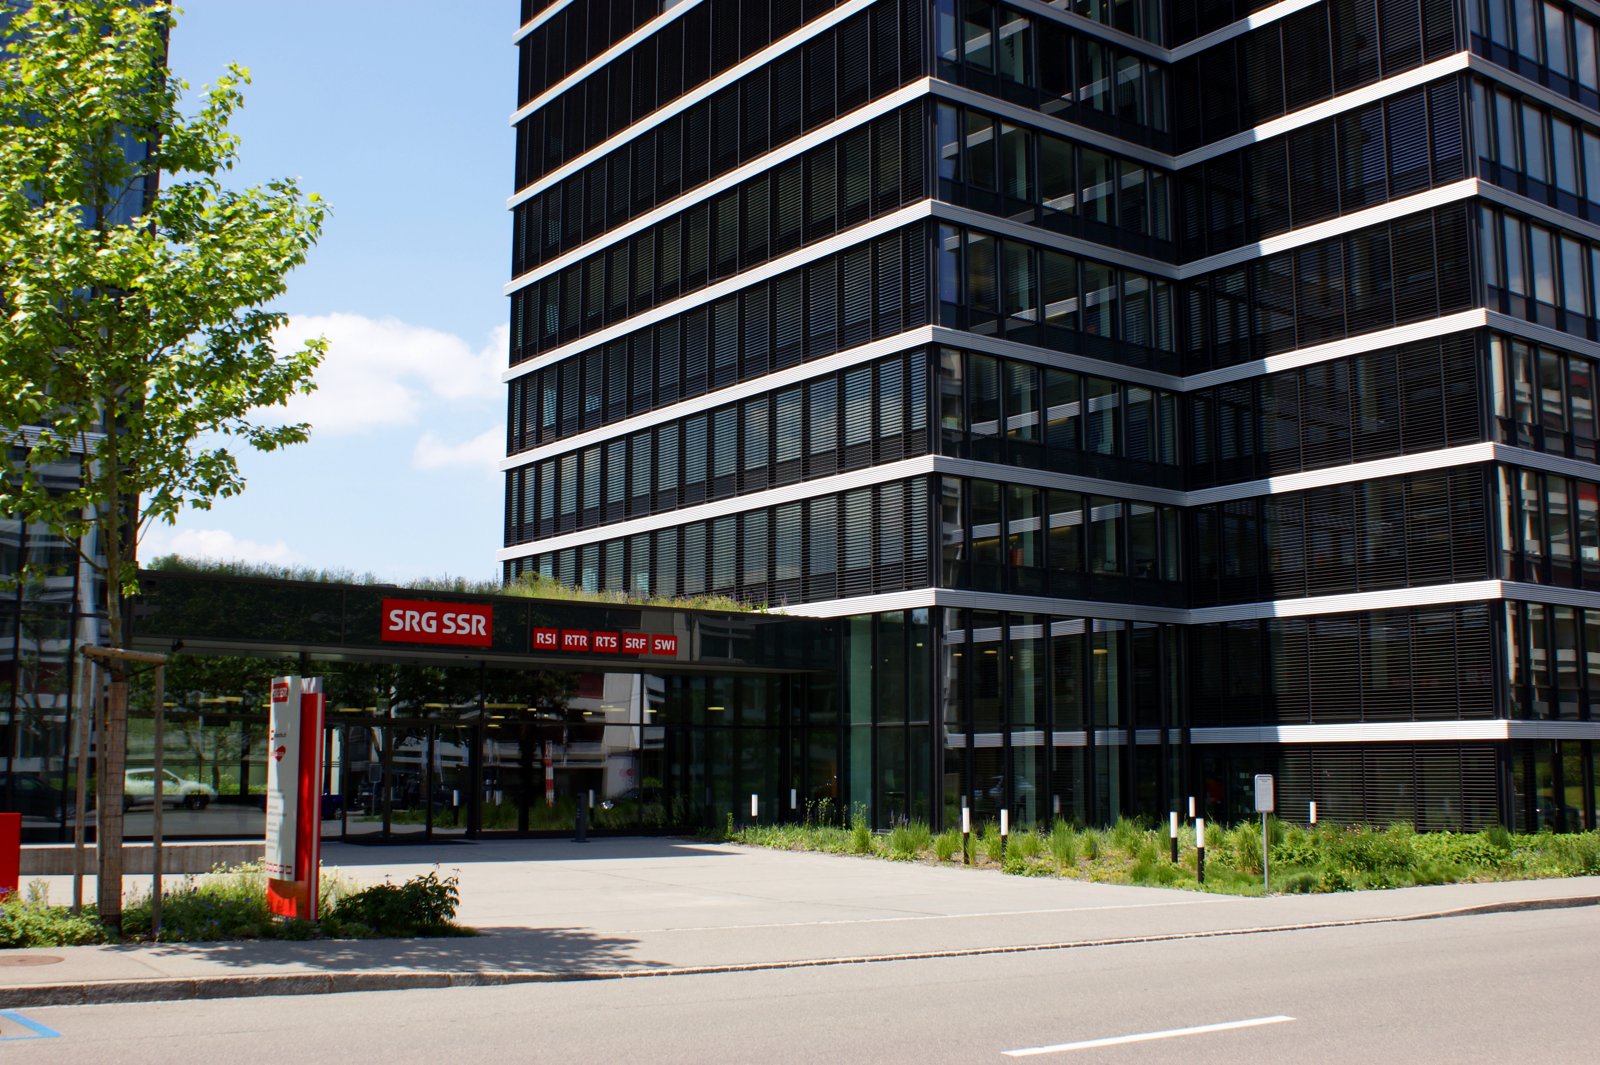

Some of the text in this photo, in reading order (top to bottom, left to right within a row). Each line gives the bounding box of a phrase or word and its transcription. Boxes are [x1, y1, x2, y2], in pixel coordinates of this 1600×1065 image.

[388, 609, 487, 636] SRG SSR
[536, 632, 675, 651] RSI RTR RTS SRF SWI
